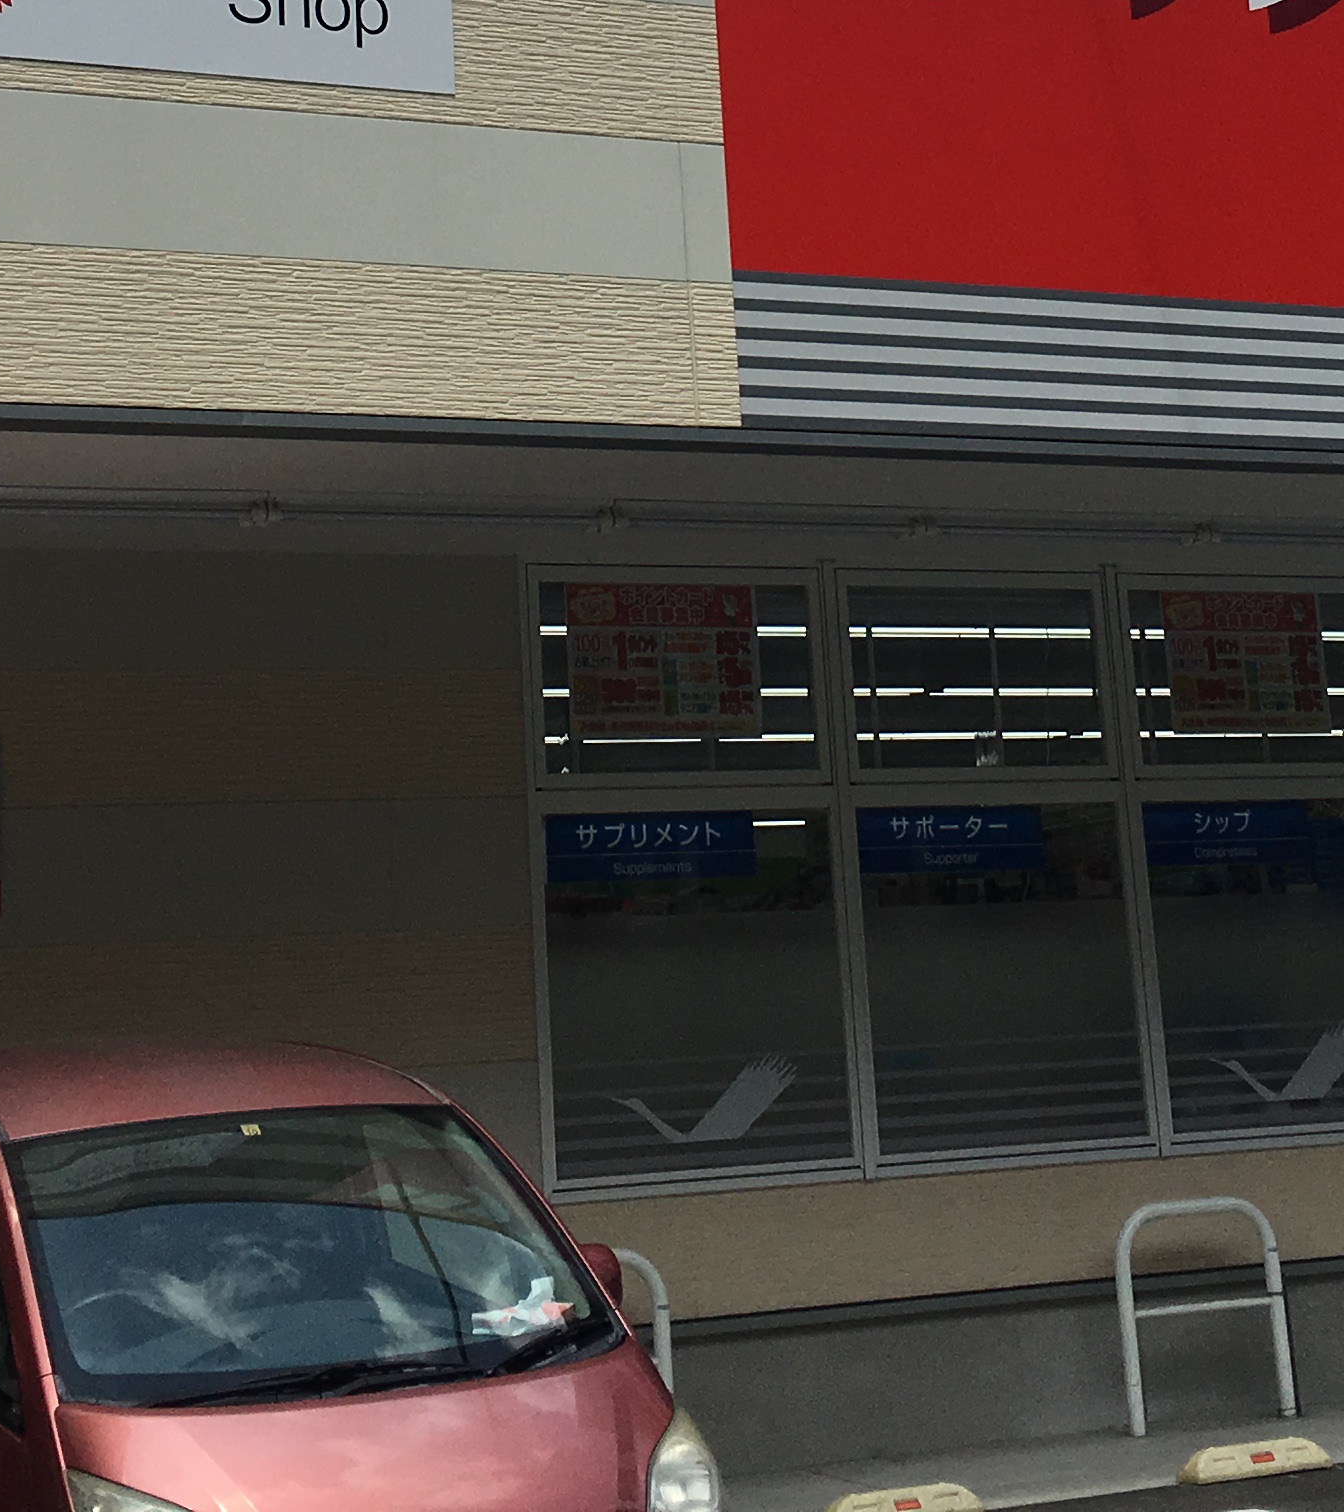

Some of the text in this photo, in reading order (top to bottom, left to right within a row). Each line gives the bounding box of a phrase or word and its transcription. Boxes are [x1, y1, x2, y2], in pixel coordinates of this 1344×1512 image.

[889, 814, 1009, 840] サポーター
[1193, 808, 1251, 834] シップ
[575, 821, 722, 849] サプリメント
[613, 861, 692, 876] Supplements
[924, 852, 980, 866] Supporter
